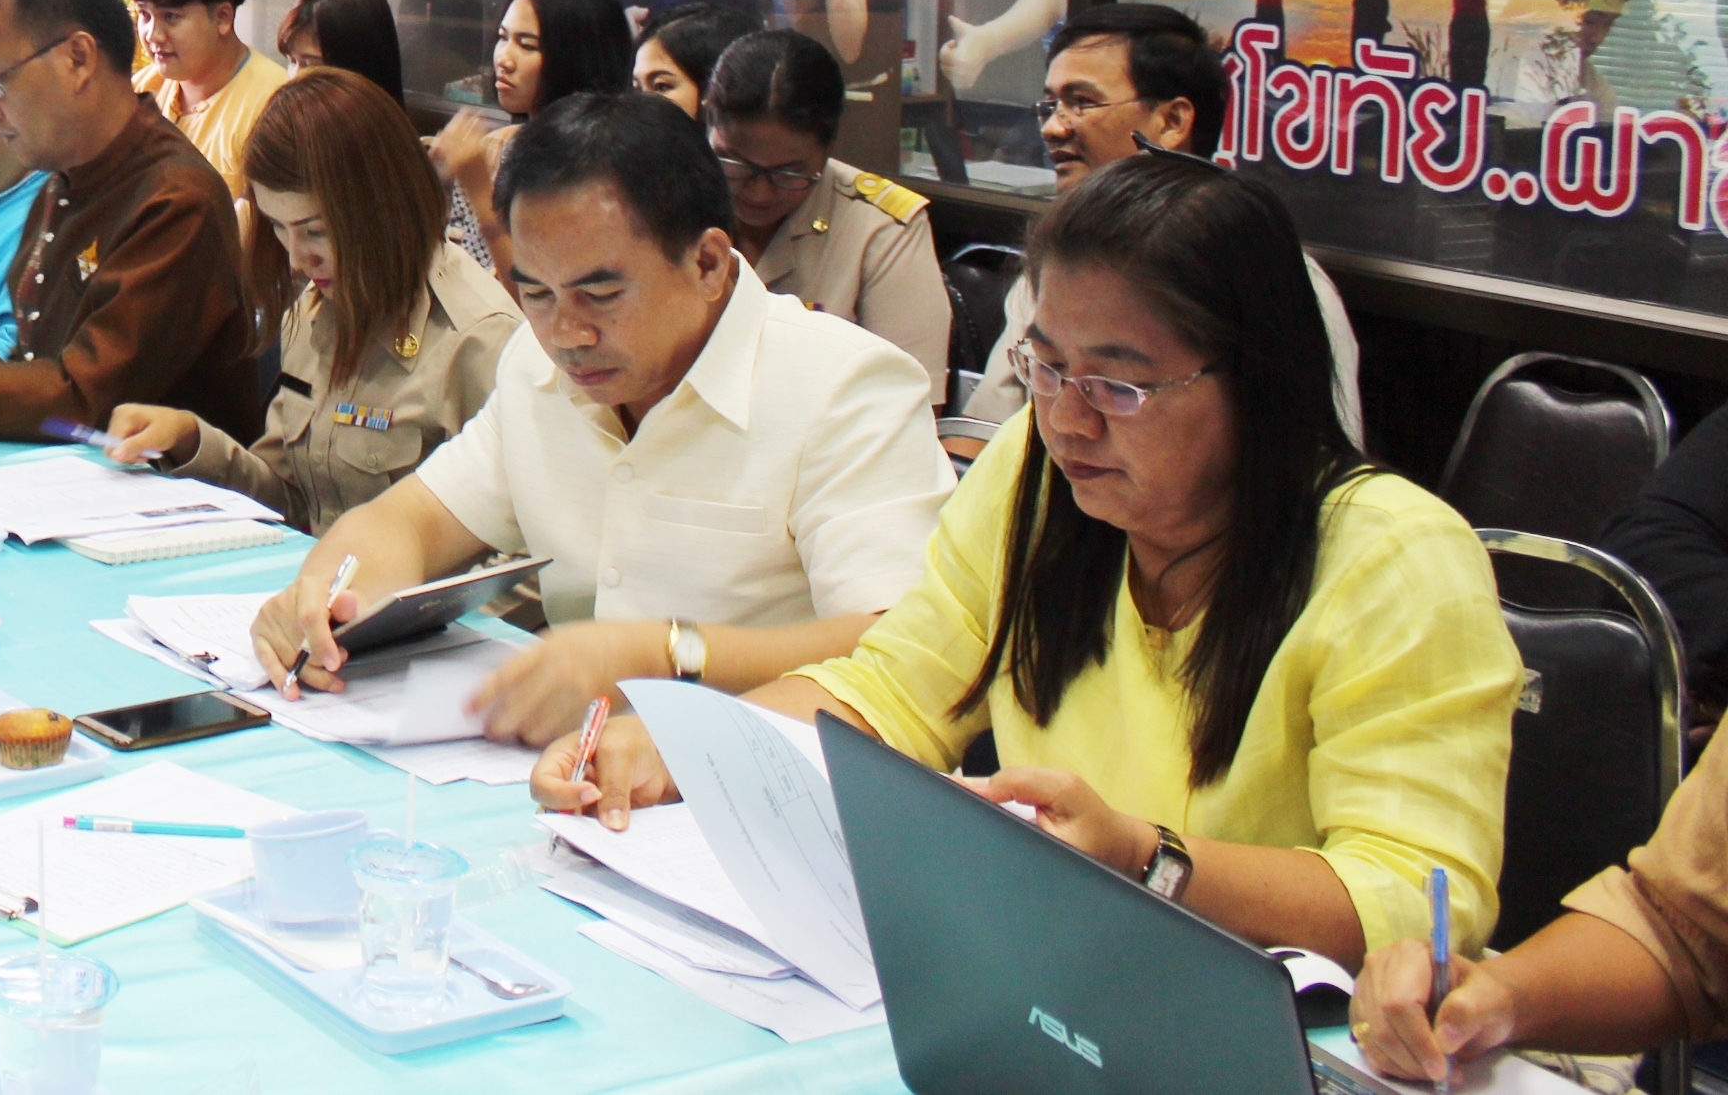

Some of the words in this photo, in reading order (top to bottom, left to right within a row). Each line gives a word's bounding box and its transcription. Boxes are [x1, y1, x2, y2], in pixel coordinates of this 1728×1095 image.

[1215, 24, 1728, 238] โขทัย..ผา
[1028, 1006, 1102, 1068] ASUS
